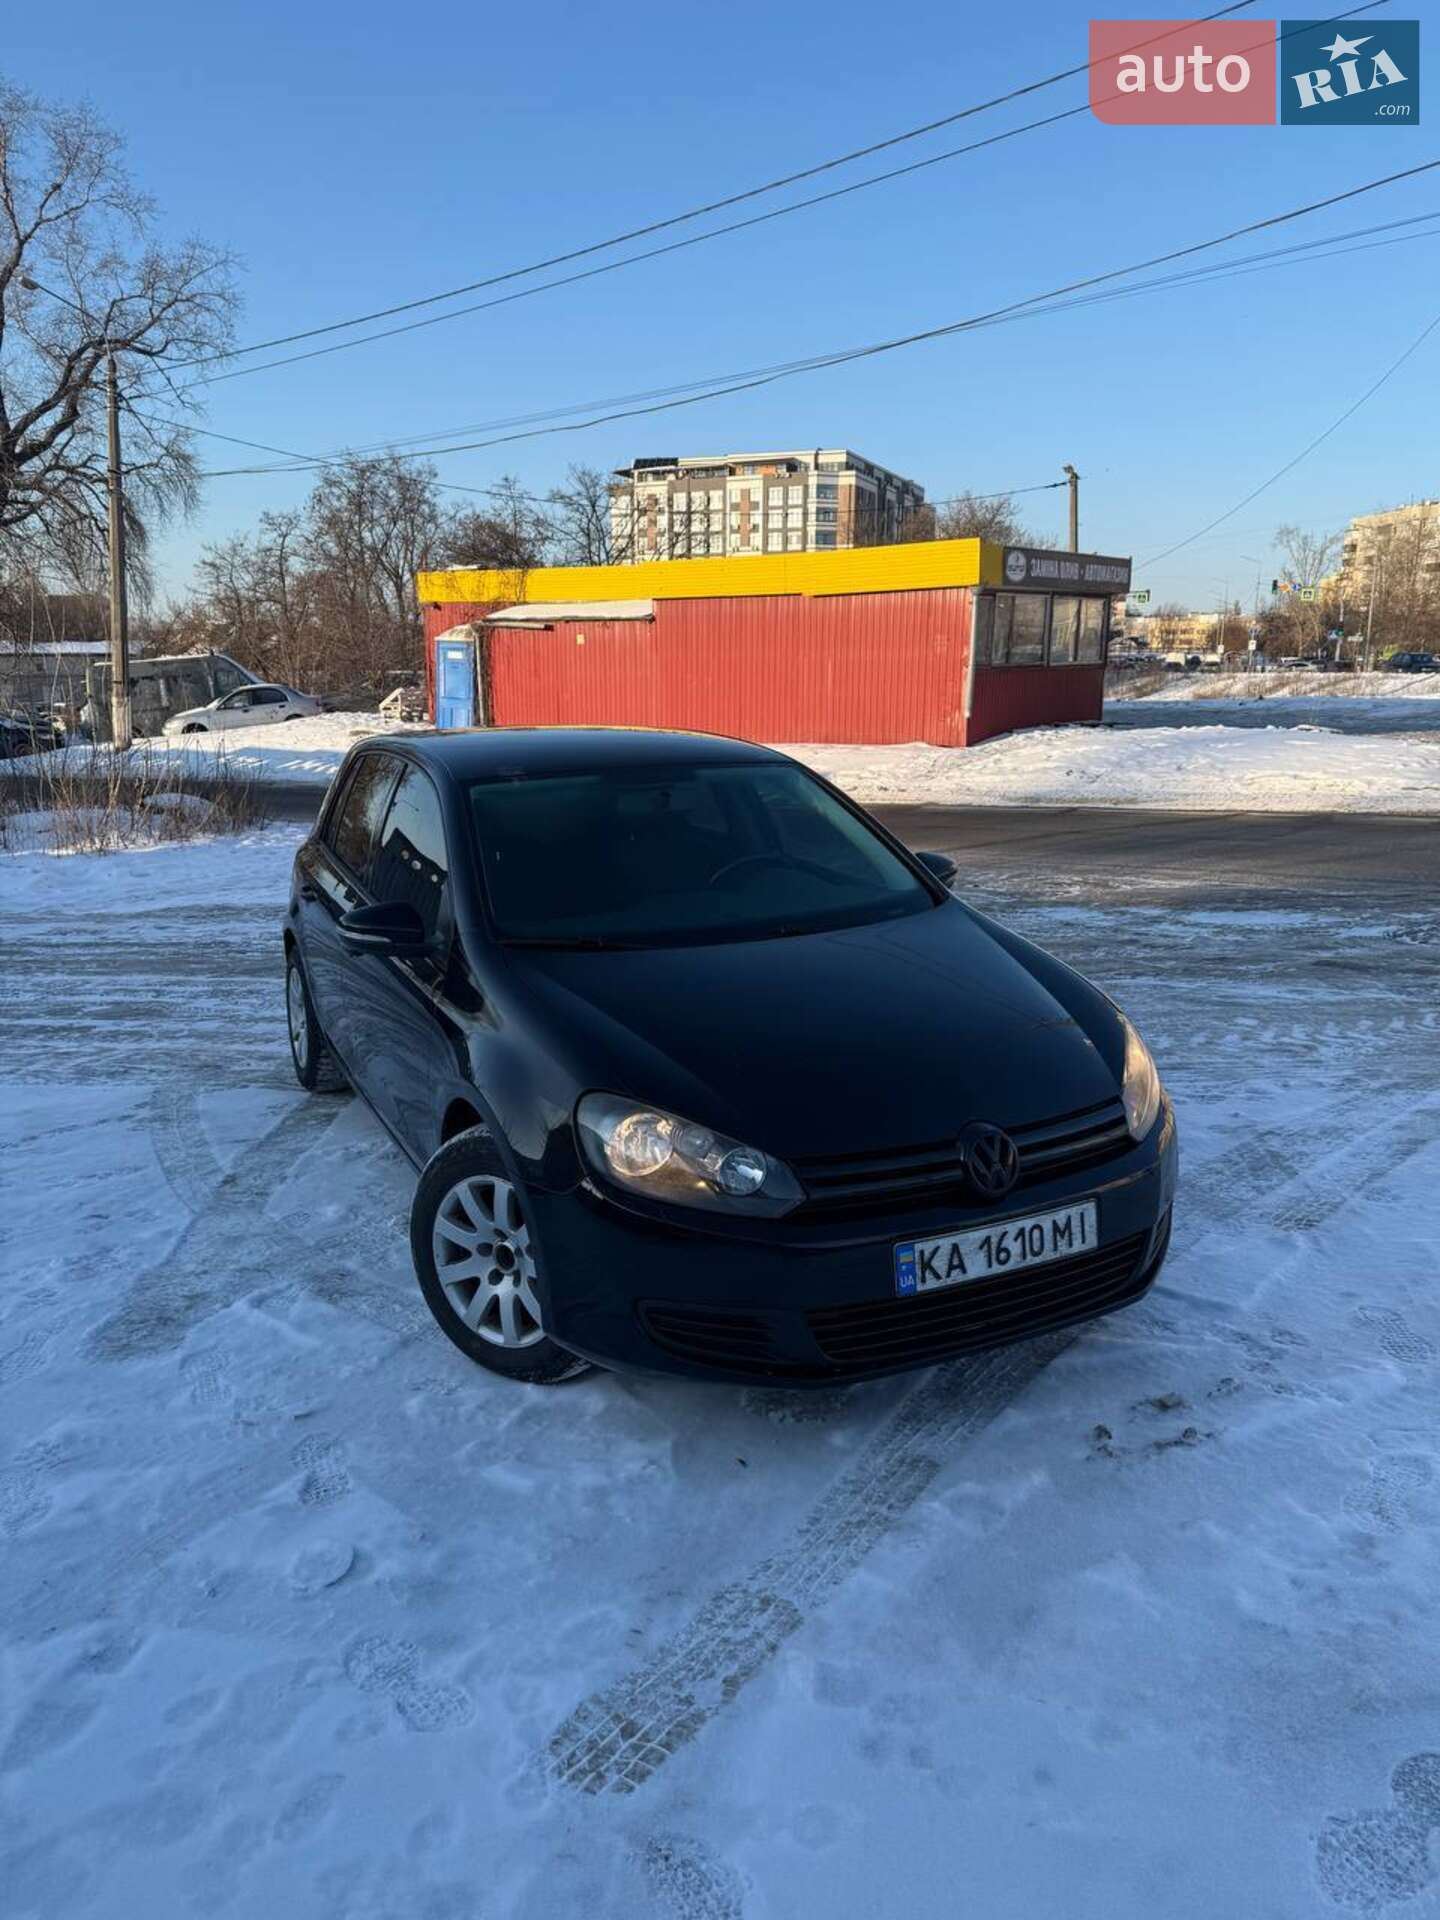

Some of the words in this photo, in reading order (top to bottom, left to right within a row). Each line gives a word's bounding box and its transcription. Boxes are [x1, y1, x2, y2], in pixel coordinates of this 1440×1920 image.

[919, 1243, 968, 1284] KA
[979, 1223, 1045, 1269] 1610
[1051, 1211, 1087, 1252] MI
[899, 1275, 915, 1288] UA
